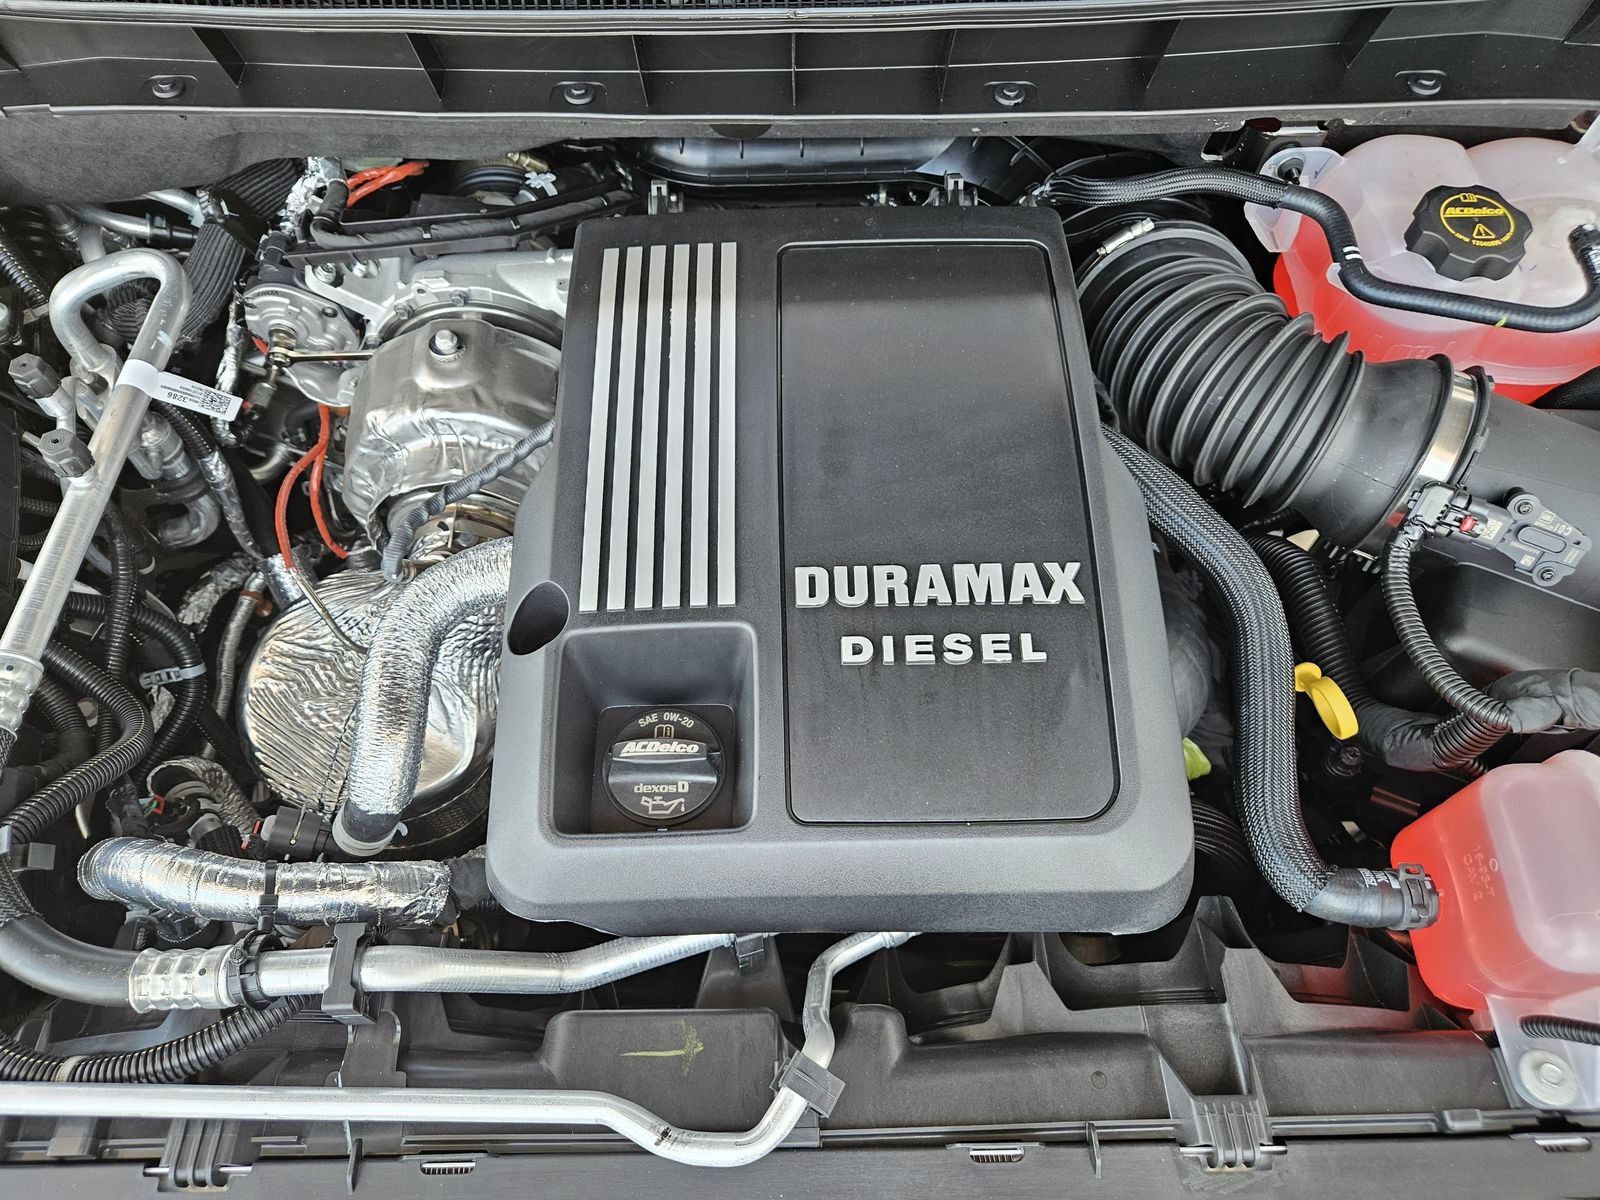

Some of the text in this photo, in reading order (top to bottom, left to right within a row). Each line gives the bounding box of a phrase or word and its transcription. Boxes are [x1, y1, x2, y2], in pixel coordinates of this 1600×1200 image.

[1444, 206, 1505, 217] ACDelco
[167, 391, 189, 404] 3286
[794, 562, 1086, 608] DURAMAX
[840, 632, 1048, 666] DIESEL
[638, 712, 695, 728] SAE 0W-20
[619, 741, 700, 756] ACDelco
[633, 781, 690, 793] dexosD
